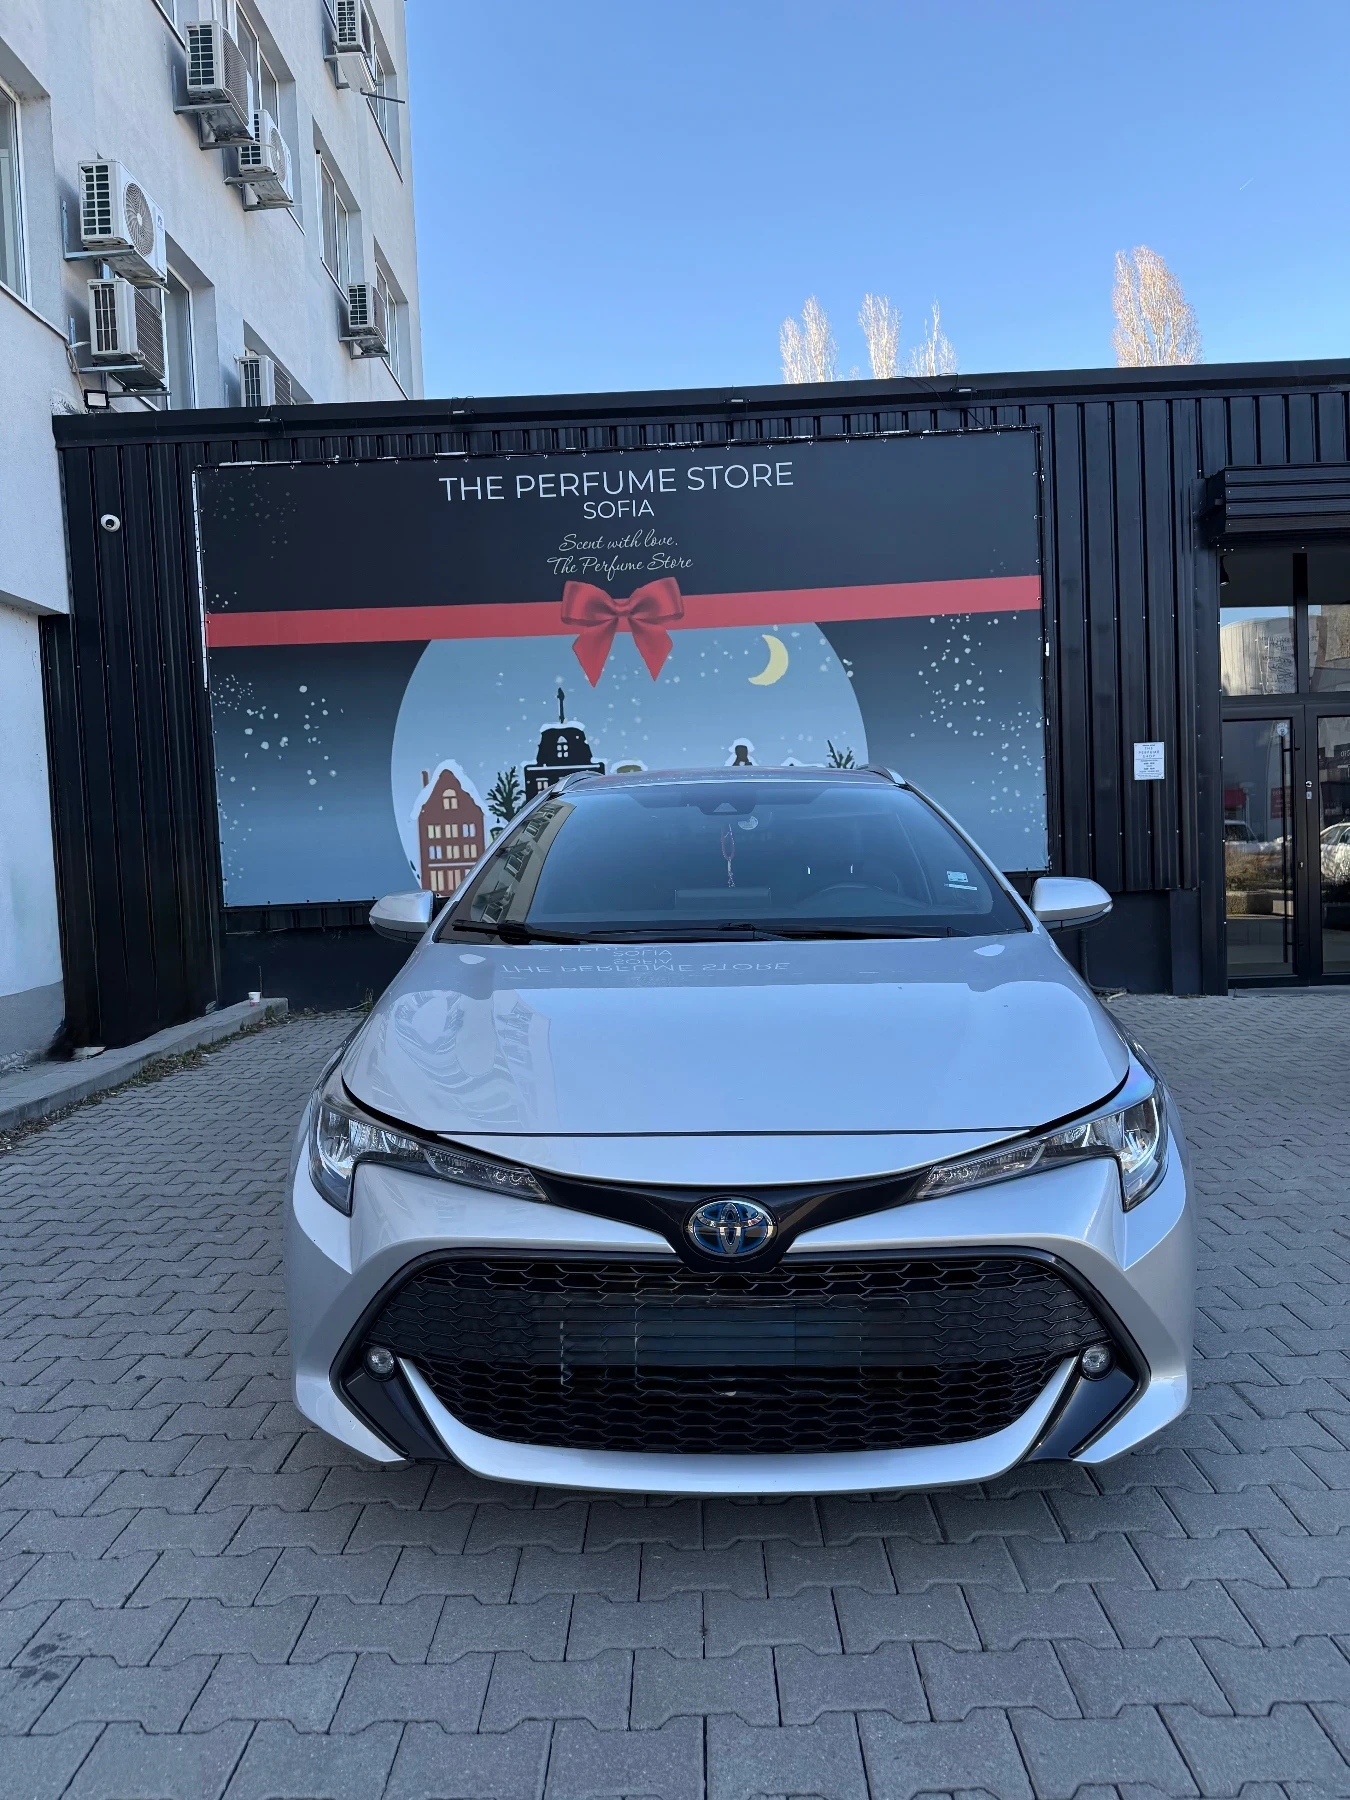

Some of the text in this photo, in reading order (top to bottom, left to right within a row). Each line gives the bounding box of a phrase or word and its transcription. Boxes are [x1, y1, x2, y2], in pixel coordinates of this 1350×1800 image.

[438, 461, 794, 502] THE PERFUME STORE
[583, 499, 655, 520] SOFIA
[558, 529, 679, 553] Scent with love.
[546, 552, 694, 582] The Perfume Store
